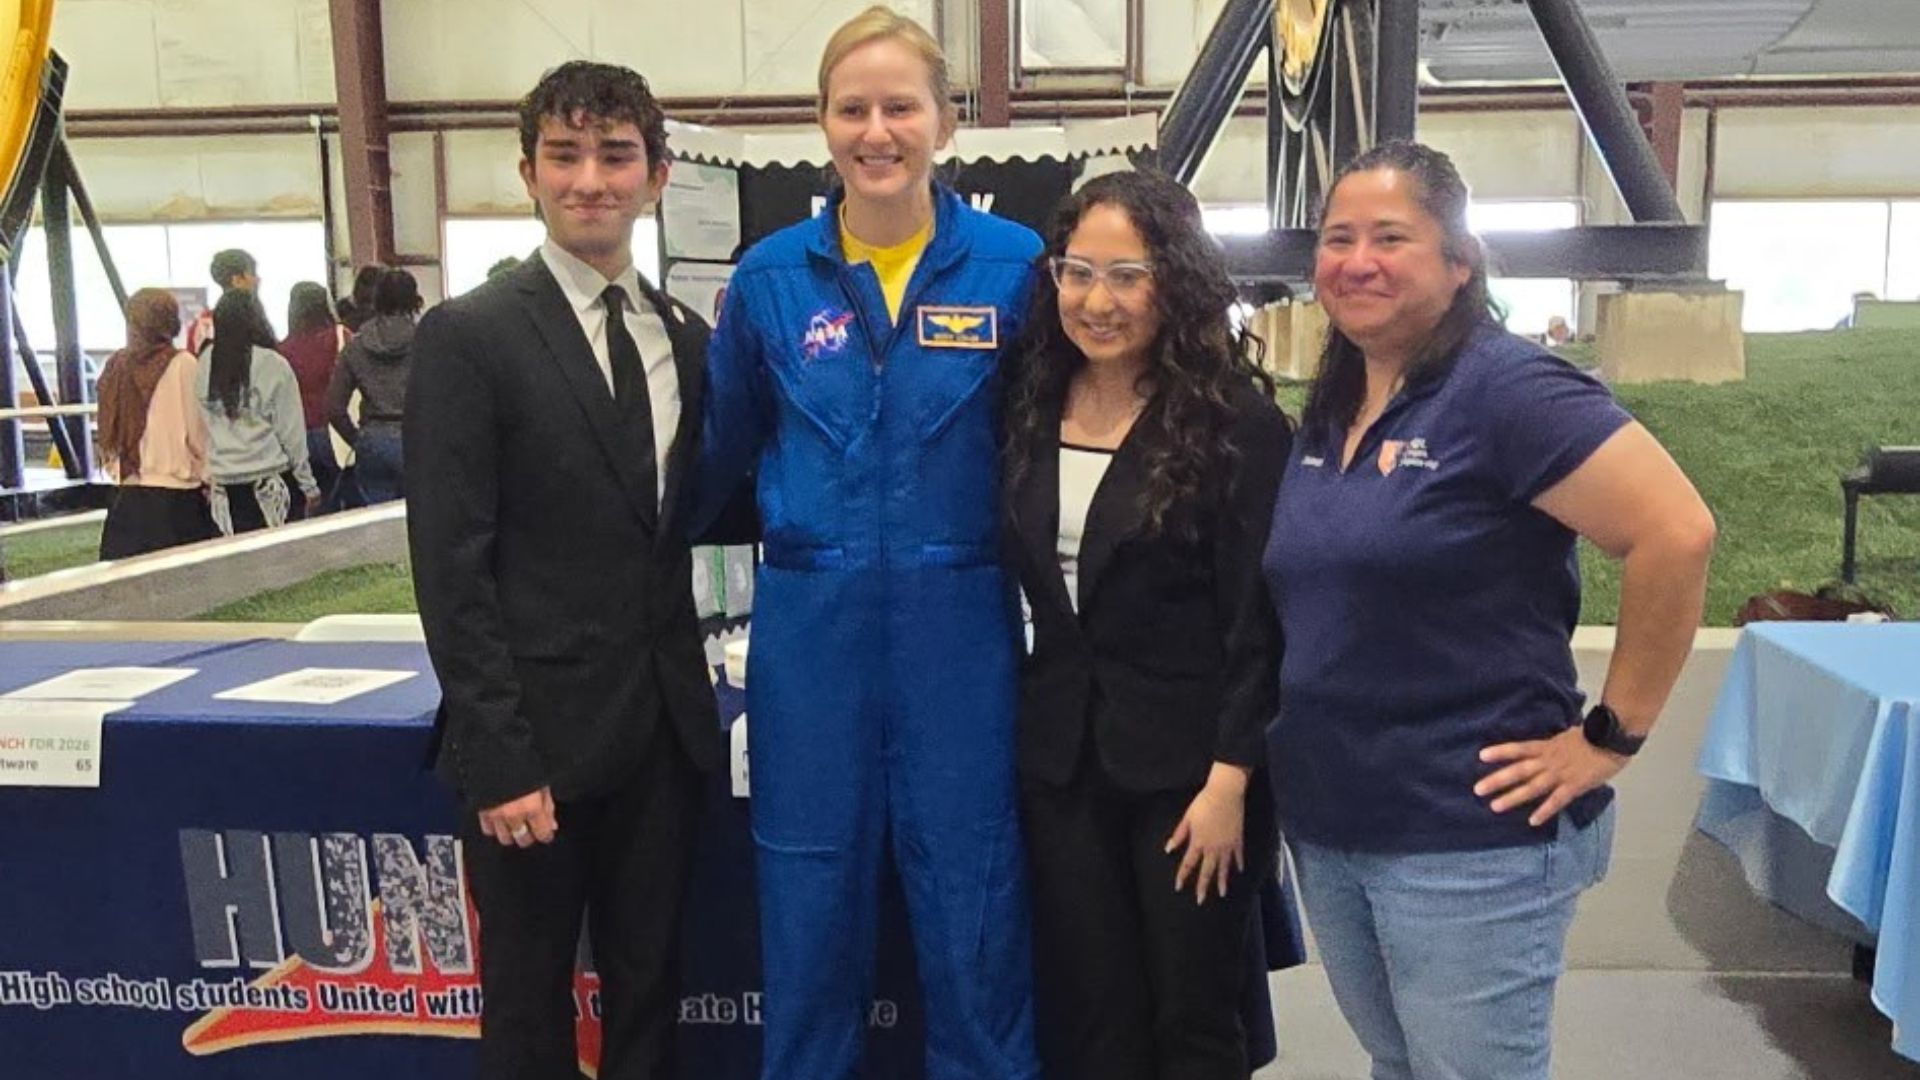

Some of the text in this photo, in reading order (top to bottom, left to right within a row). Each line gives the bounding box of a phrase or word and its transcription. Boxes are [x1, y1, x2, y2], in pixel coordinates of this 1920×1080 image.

[29, 738, 55, 751] FDR
[58, 739, 91, 752] 2026
[76, 759, 92, 772] 65
[179, 828, 474, 975] HUN
[0, 971, 71, 1009] High
[75, 973, 171, 1009] school
[177, 977, 310, 1012] students
[316, 981, 418, 1016] United
